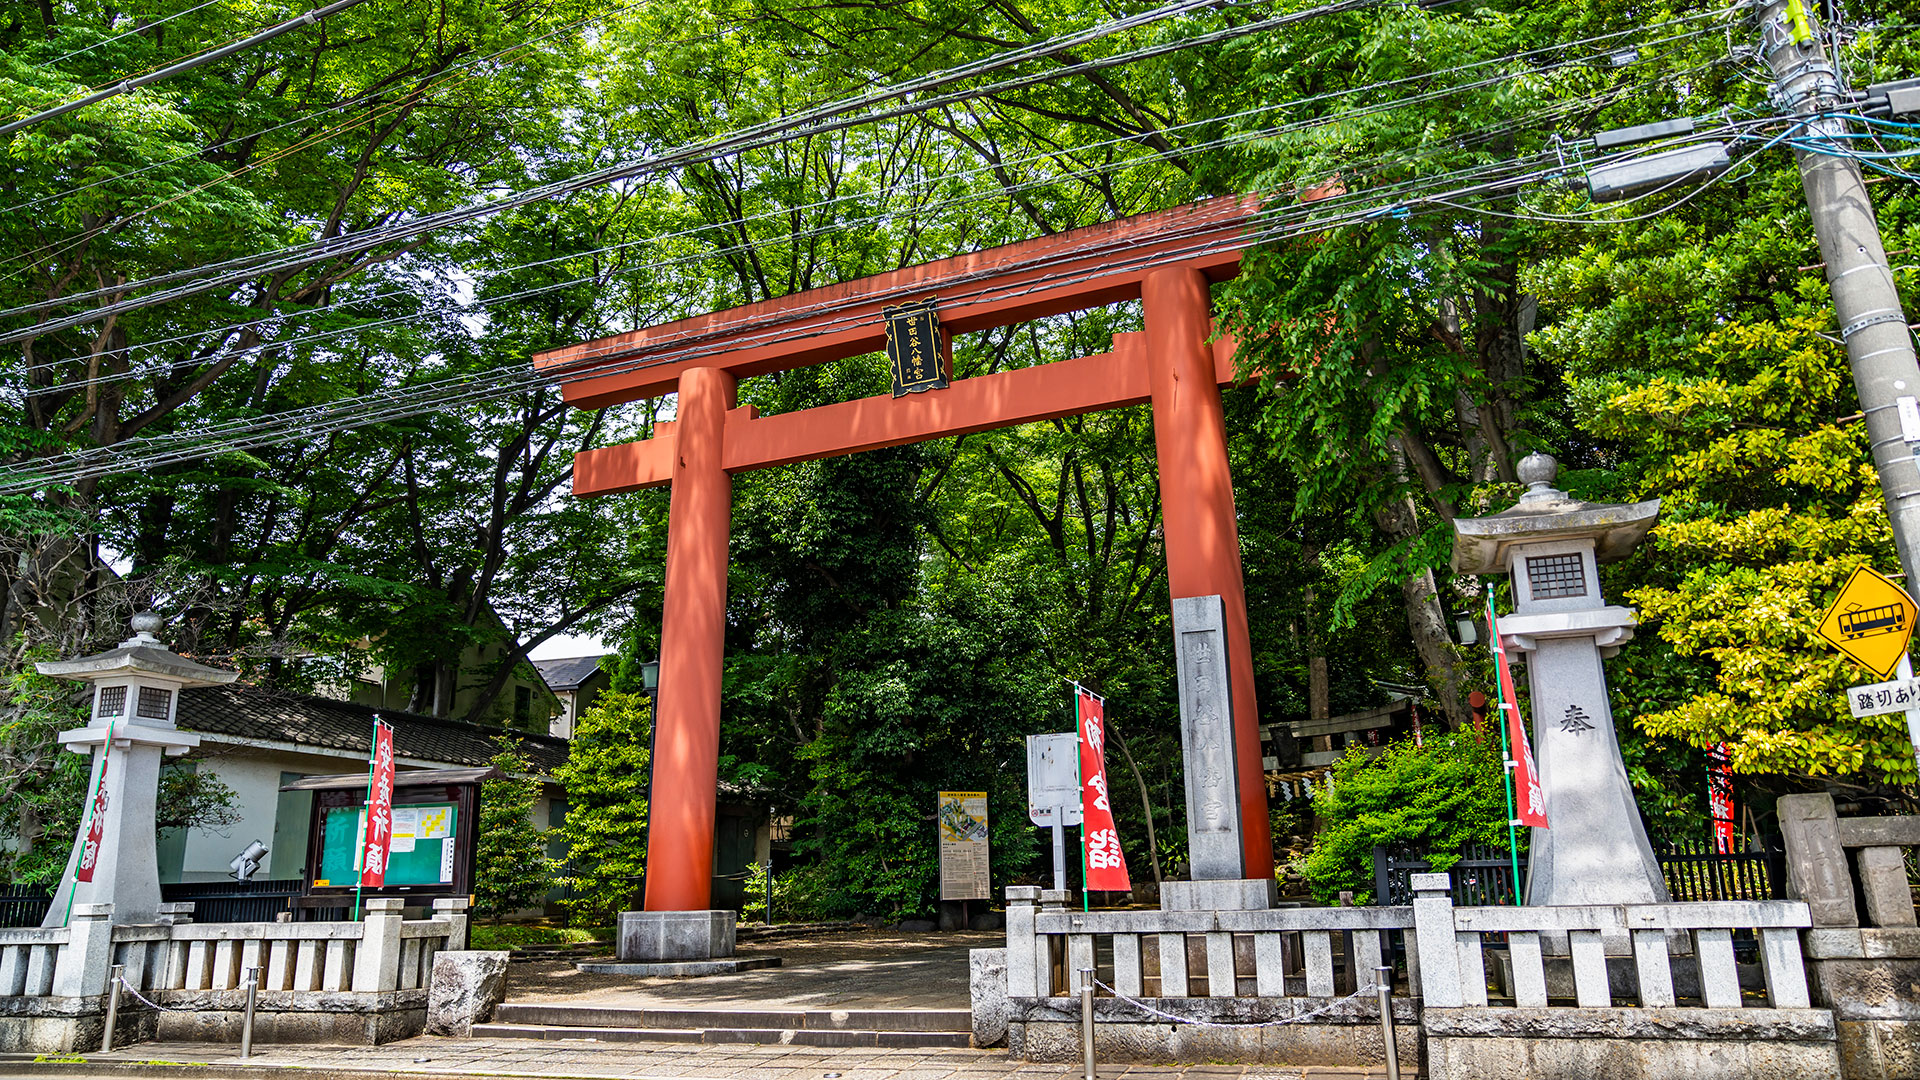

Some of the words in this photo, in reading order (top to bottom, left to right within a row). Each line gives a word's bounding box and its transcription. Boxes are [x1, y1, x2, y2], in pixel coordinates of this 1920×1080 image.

[907, 317, 923, 379] 世田谷八幡宮
[1193, 641, 1223, 821] 世田谷八幡宮
[1560, 704, 1596, 737] 奉
